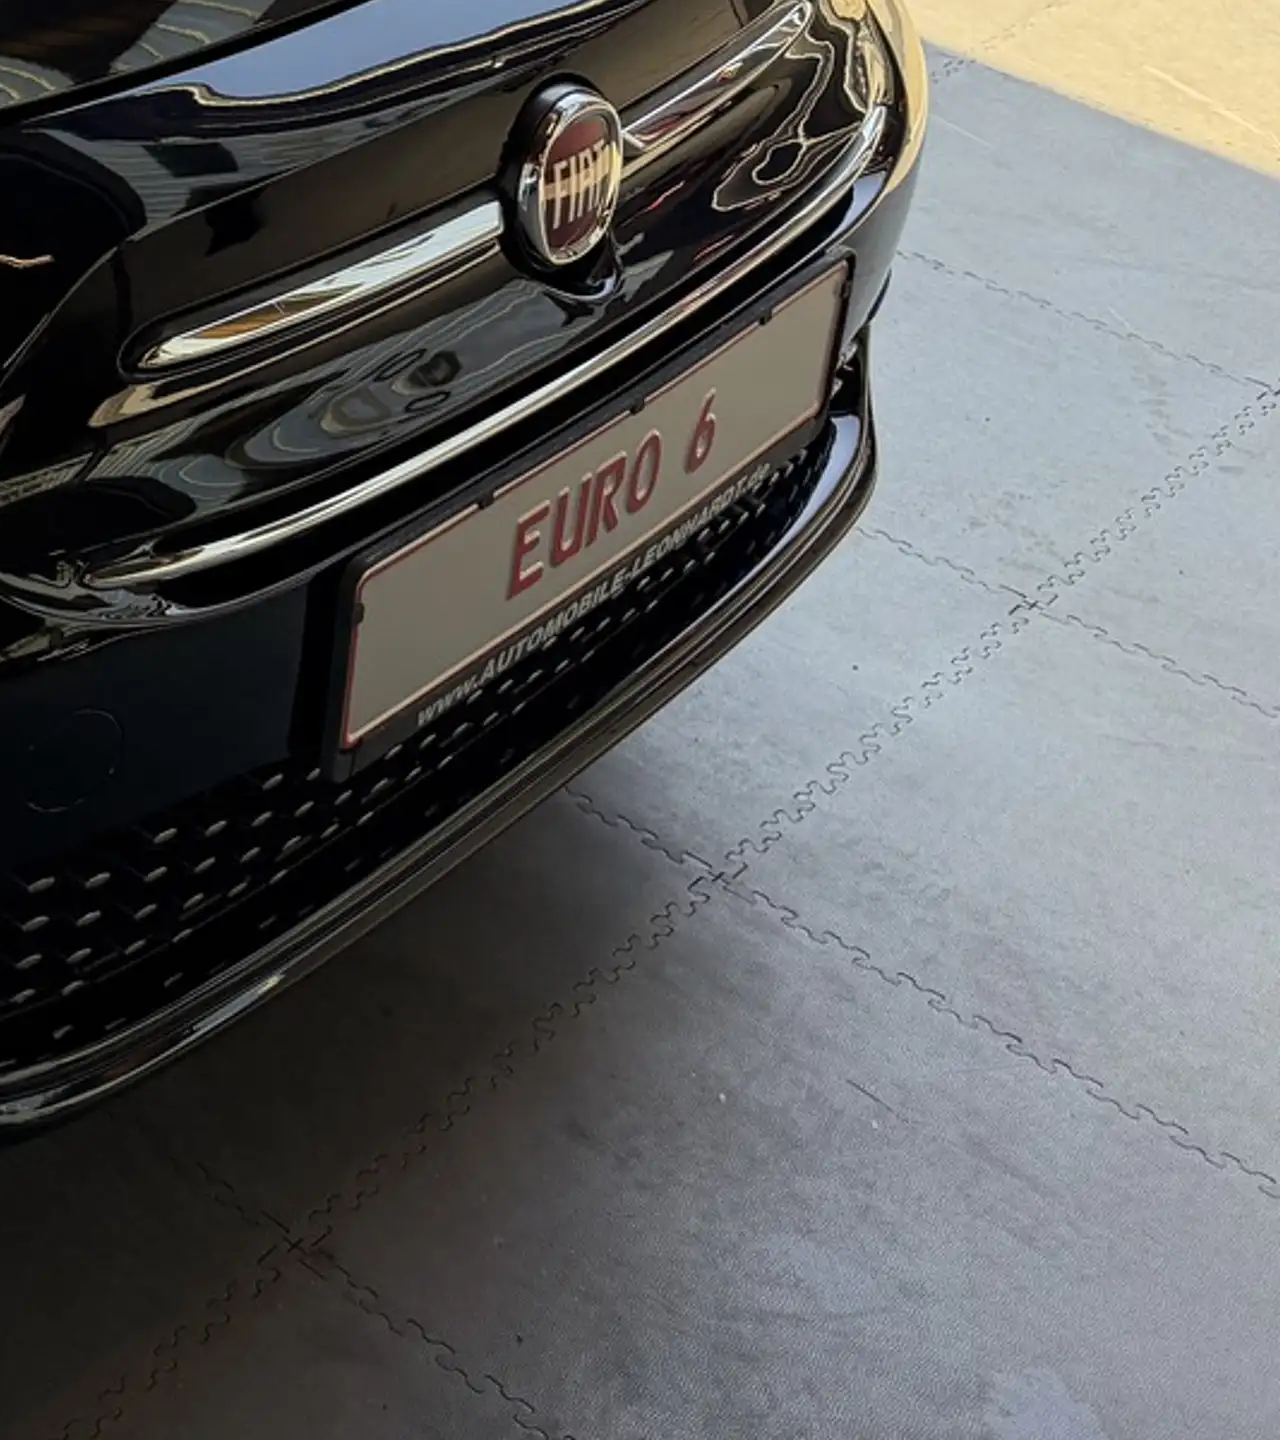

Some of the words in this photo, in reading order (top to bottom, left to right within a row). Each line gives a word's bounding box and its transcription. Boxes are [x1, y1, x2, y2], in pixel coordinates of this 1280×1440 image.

[552, 138, 608, 231] FIAT
[505, 428, 662, 601] EURO
[684, 387, 718, 475] 6
